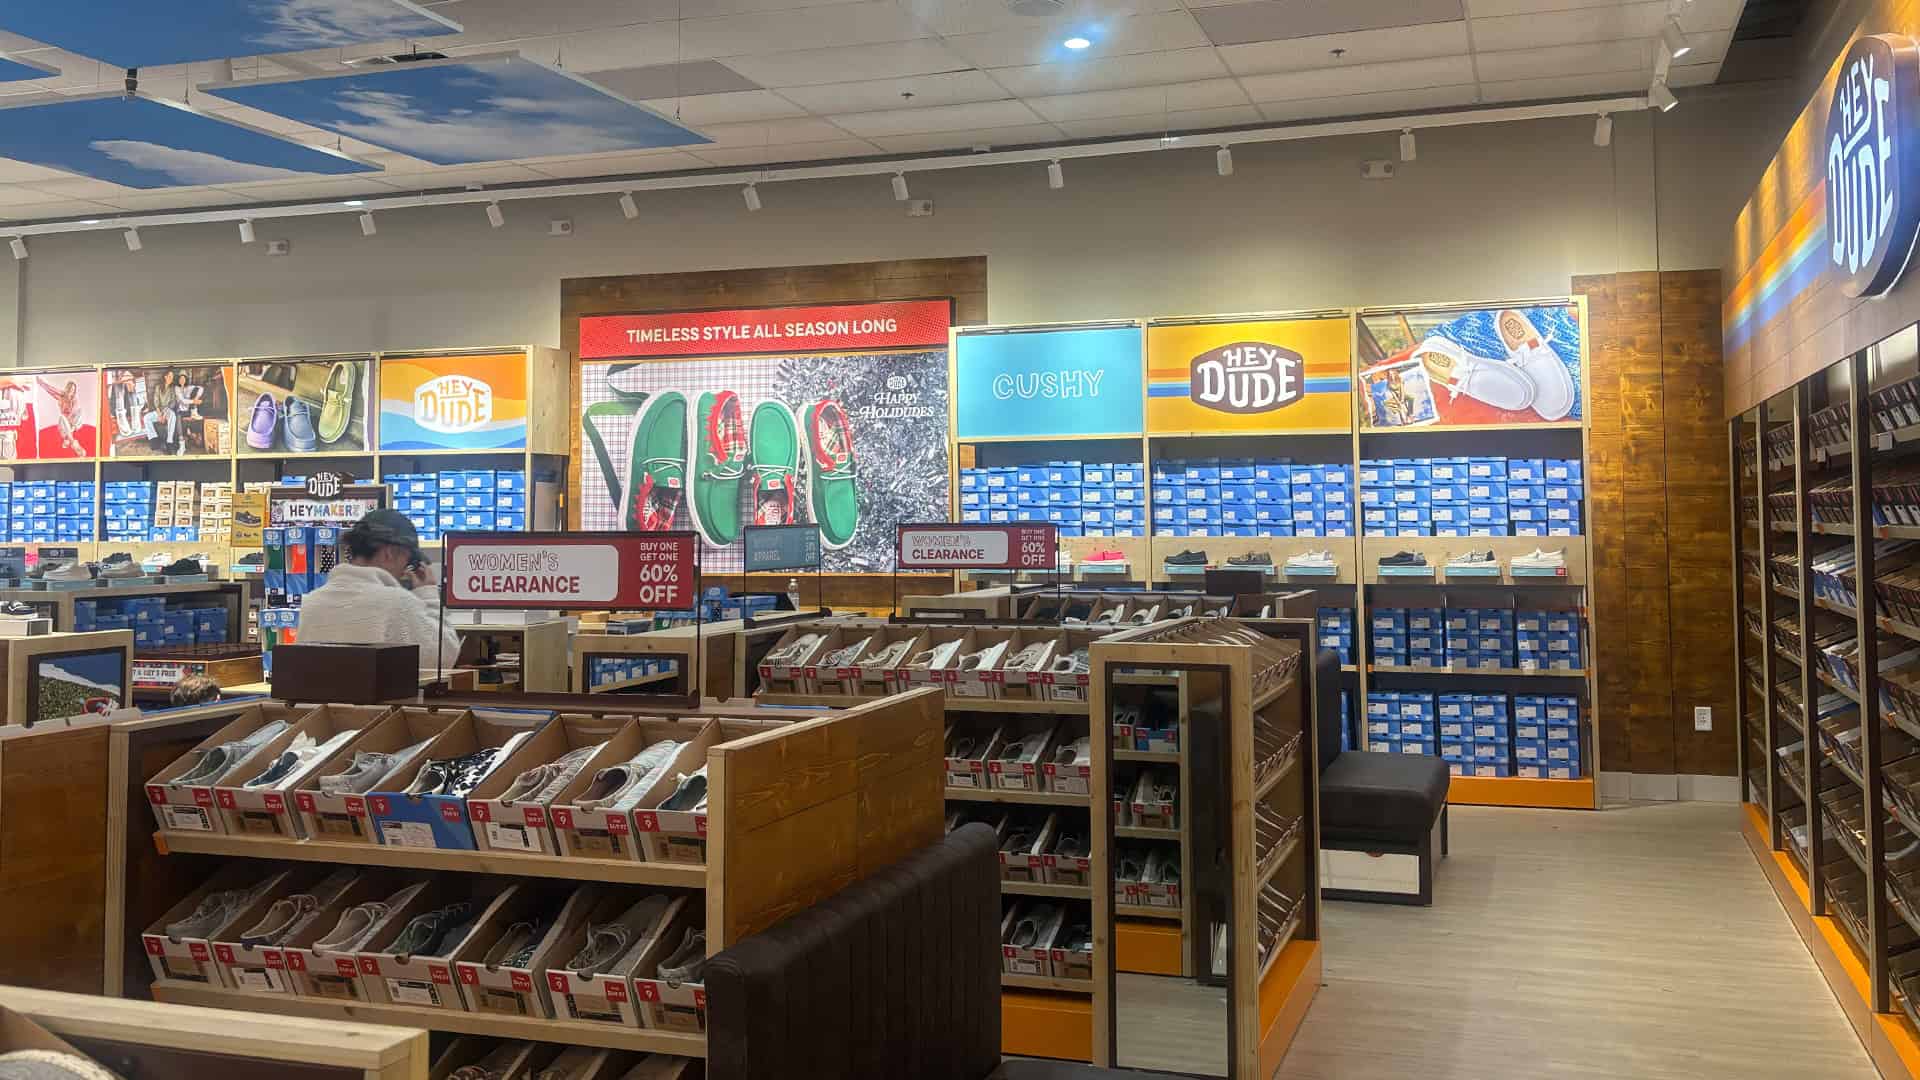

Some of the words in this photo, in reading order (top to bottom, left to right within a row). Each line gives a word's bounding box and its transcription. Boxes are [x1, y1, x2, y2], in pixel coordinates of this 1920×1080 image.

[1840, 53, 1874, 160] HEY
[1829, 78, 1893, 275] DUDE
[627, 326, 699, 343] TIMELESS
[703, 325, 750, 340] STYLE
[753, 323, 782, 338] ALL
[785, 320, 849, 337] SEASON
[852, 318, 897, 334] LONG
[1222, 346, 1278, 372] HEY
[437, 379, 473, 399] HEY
[992, 368, 1104, 400] CUSHY
[1197, 357, 1297, 408] DUDE
[420, 388, 486, 427] DUDE
[860, 404, 935, 418] HOLIDUDES
[317, 471, 335, 482] HEY
[308, 476, 340, 497] DUDE
[640, 542, 657, 551] BUY
[658, 542, 678, 551] ONE
[912, 549, 984, 560] CLEARANCE
[1022, 542, 1045, 553] 60%
[468, 550, 559, 572] WOMEN'S
[640, 552, 657, 561] GET
[658, 552, 678, 561] ONE
[1022, 554, 1045, 565] OFF
[639, 564, 678, 583] 60%
[468, 575, 580, 593] CLEARANCE
[639, 585, 678, 604] OFF
